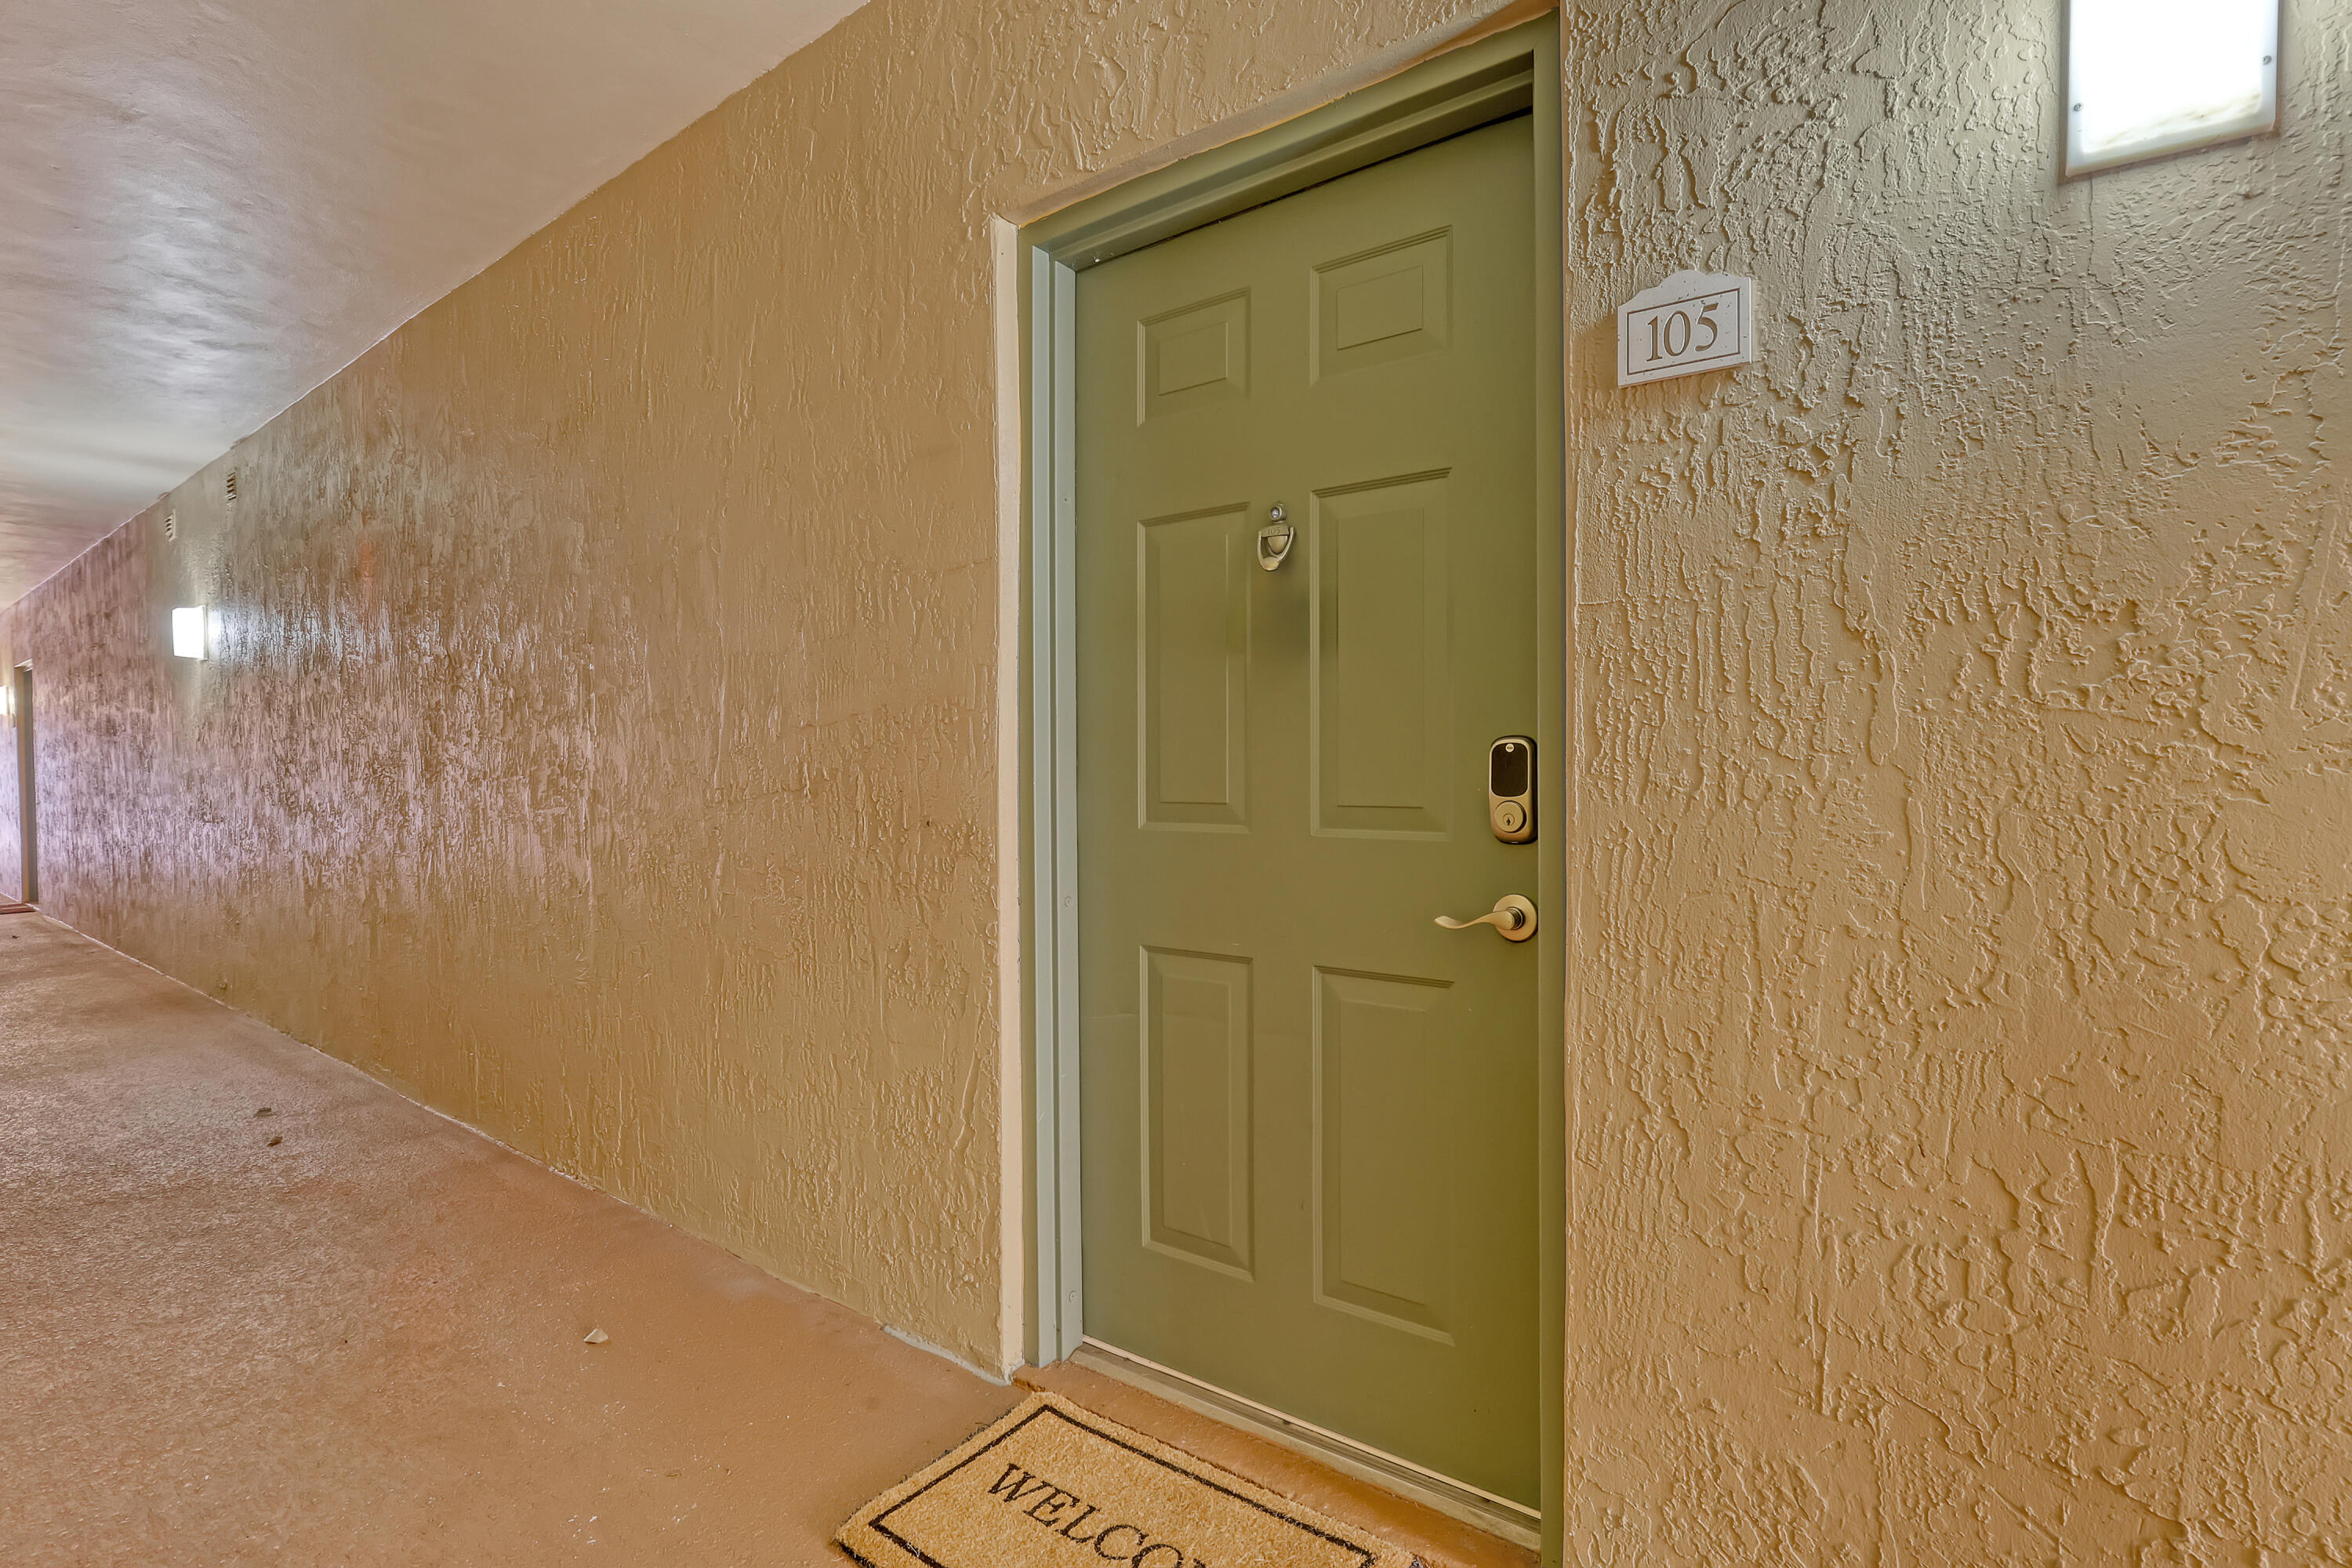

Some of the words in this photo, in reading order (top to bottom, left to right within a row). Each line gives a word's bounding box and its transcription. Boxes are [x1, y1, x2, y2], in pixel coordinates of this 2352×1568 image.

[1646, 302, 1719, 362] 105
[1268, 527, 1280, 535] 105
[988, 1463, 1207, 1568] WELCO
